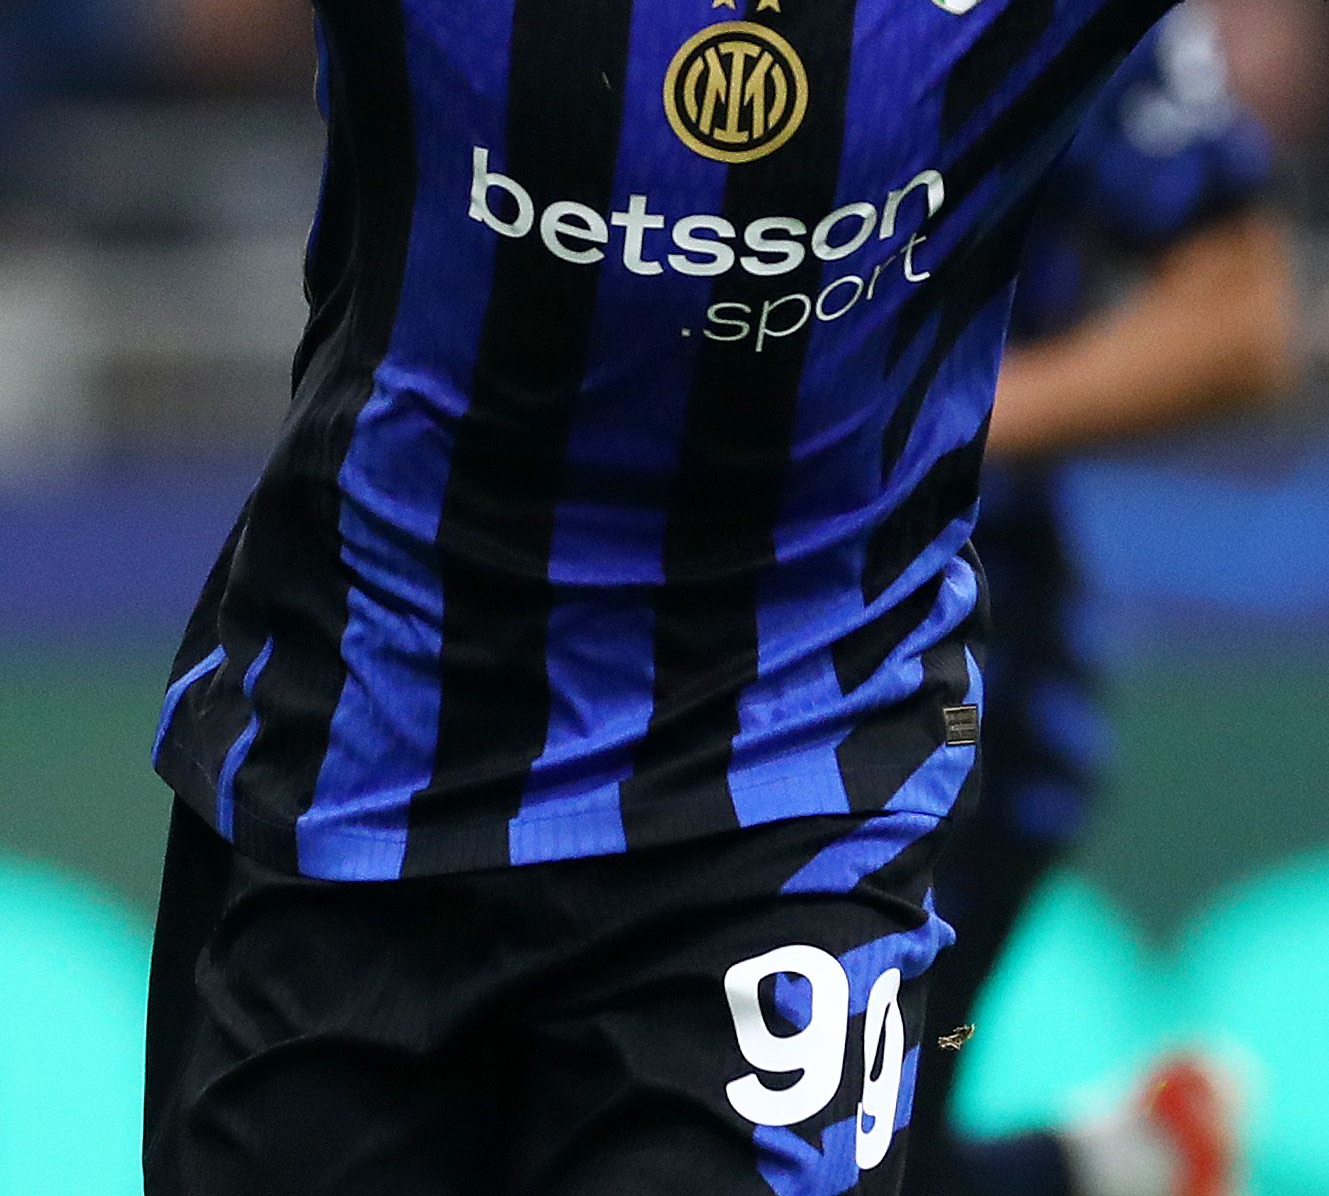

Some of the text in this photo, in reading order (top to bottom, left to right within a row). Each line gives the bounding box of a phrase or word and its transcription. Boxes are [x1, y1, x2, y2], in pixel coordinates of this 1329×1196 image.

[469, 146, 945, 277] betsson
[680, 232, 932, 352] .sport
[724, 943, 905, 1170] 99
